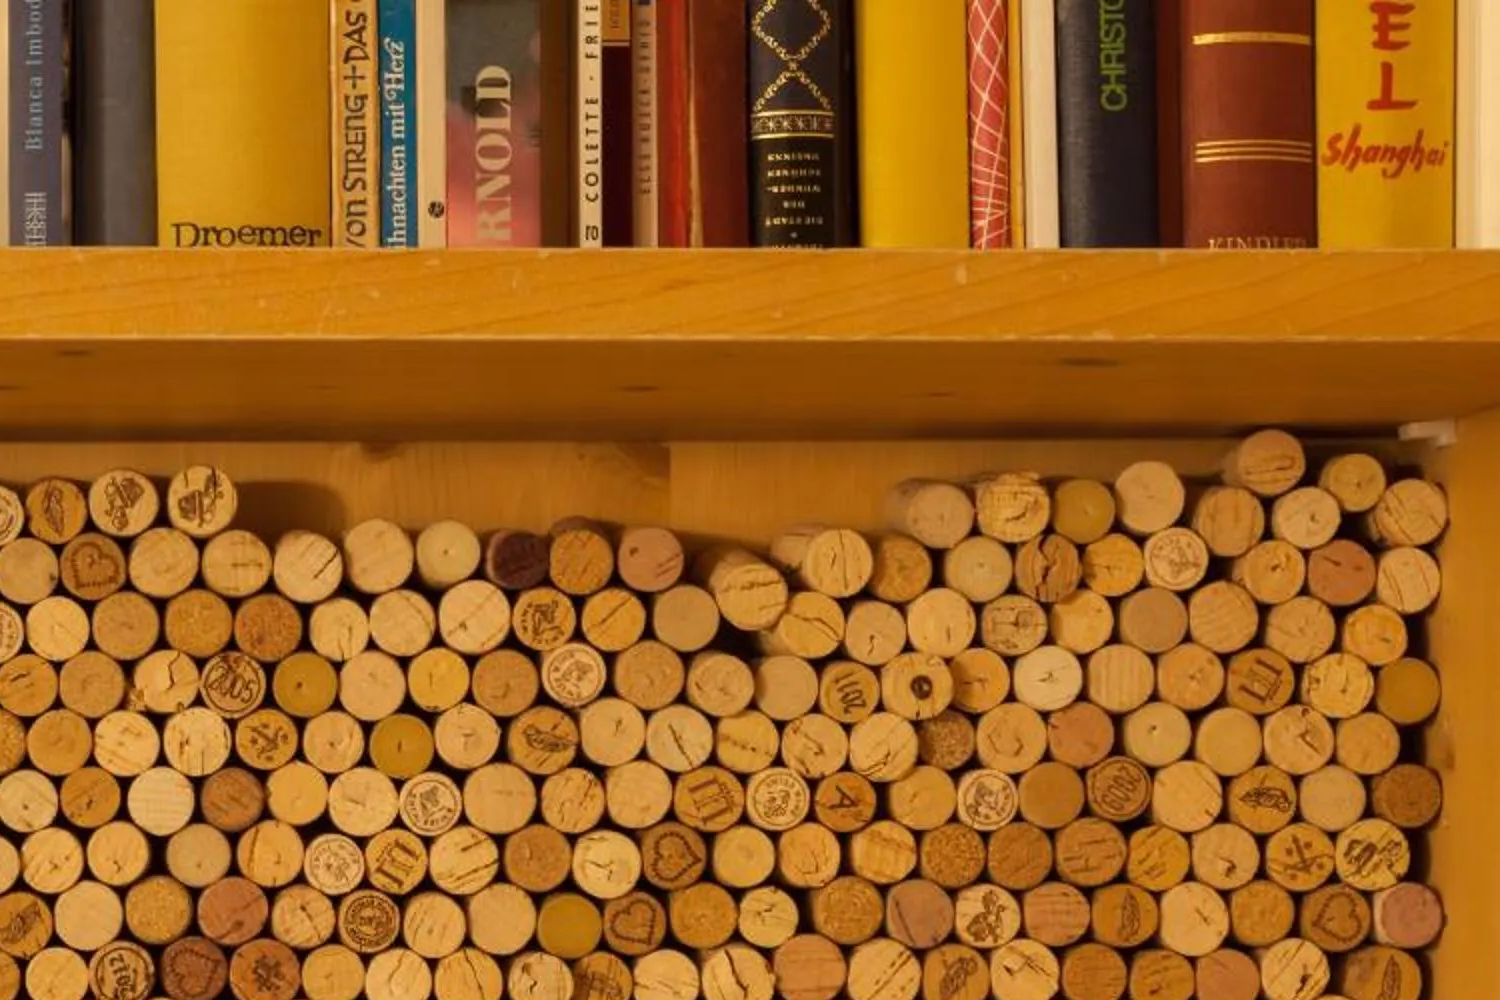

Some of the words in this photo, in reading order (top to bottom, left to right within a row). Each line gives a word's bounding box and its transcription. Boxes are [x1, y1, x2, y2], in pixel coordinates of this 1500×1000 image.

[382, 36, 405, 100] Herz
[26, 76, 43, 150] Blanca
[385, 102, 405, 139] mit
[476, 65, 513, 241] RNOLD
[585, 97, 598, 203] COLETTE
[1321, 123, 1449, 179] Shanghai
[171, 222, 322, 248] Droemer
[835, 672, 866, 714] 2011
